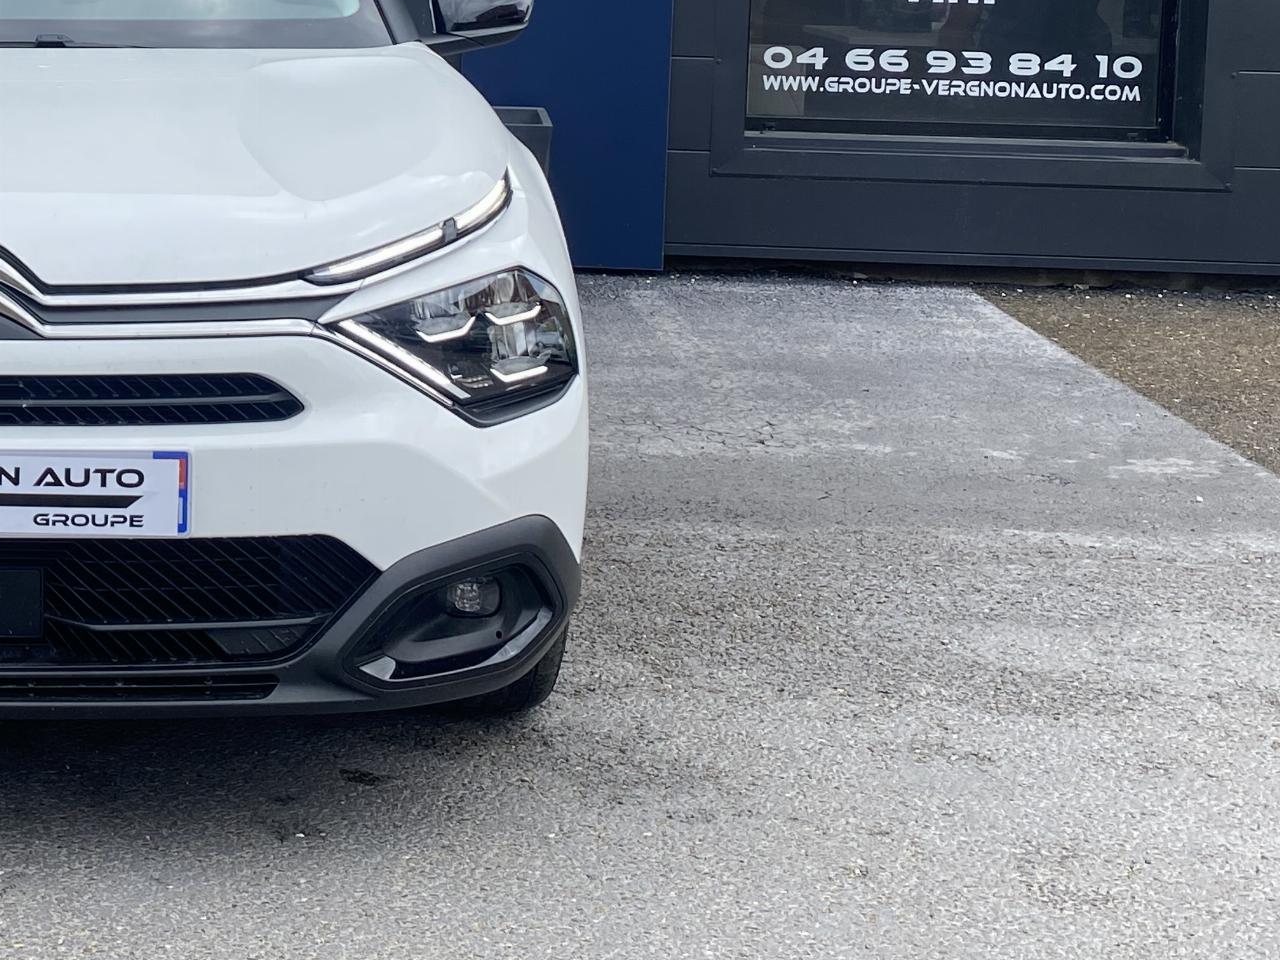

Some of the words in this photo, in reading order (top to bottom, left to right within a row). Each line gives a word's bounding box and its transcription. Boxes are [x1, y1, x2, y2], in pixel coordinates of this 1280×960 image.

[763, 46, 828, 70] 04
[845, 49, 910, 72] 66
[926, 51, 992, 75] 93
[1008, 53, 1077, 77] 84
[1095, 54, 1143, 79] 10
[762, 75, 1141, 101] WWW.GROUPE-VERGNONAUTO.COM
[33, 467, 144, 488] AUTO
[33, 513, 144, 528] GROUPE
